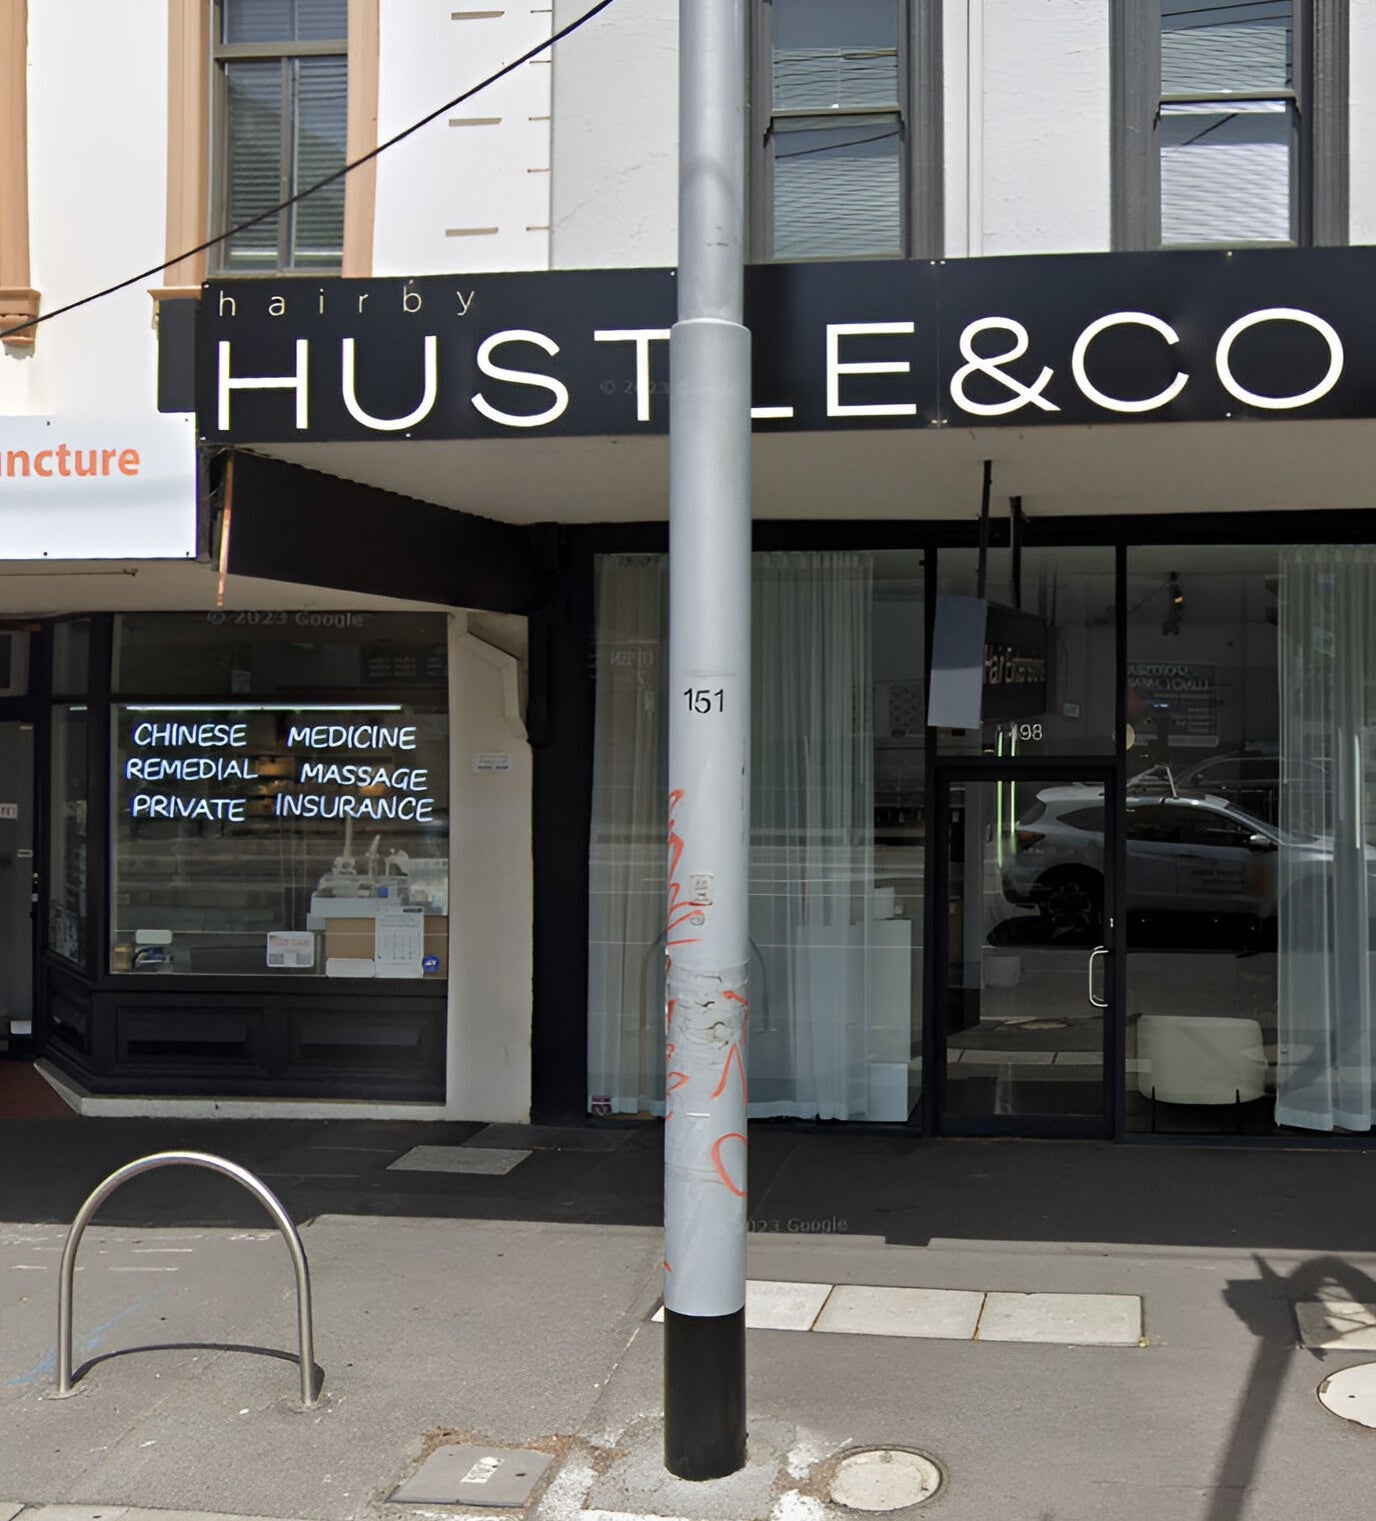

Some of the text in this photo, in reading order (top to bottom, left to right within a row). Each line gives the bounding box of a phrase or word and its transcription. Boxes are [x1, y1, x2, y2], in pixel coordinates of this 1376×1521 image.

[0, 443, 141, 477] ncture
[683, 687, 724, 714] 151
[132, 723, 417, 750] CHINESE MEDICINE
[125, 757, 429, 792] REMEDIAL MASSAGE
[130, 793, 435, 823] PRIVATE INSURANCE
